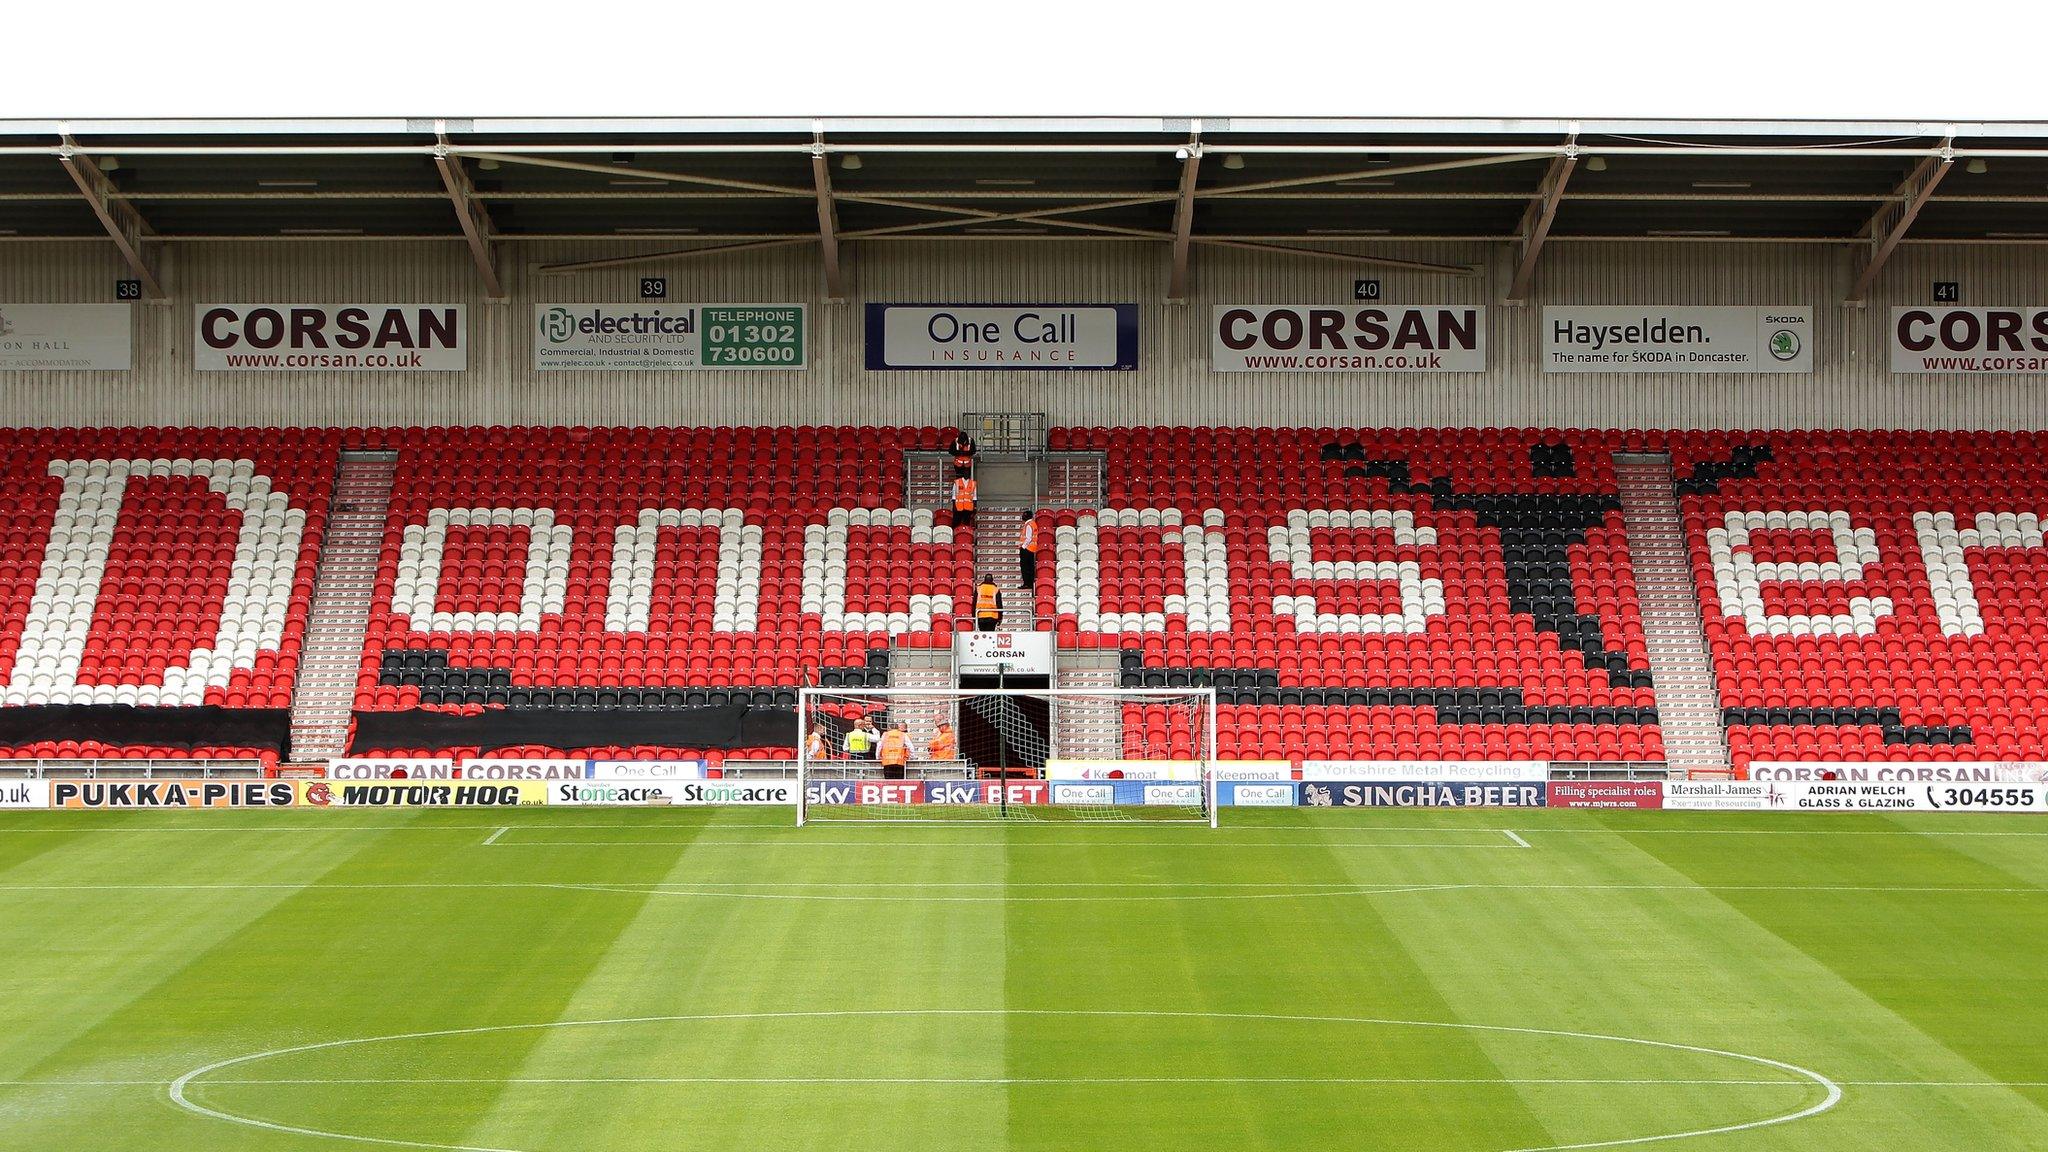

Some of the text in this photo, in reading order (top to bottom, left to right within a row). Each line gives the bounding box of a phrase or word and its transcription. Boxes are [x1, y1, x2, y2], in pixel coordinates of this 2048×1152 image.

[119, 282, 139, 297] 38
[643, 281, 663, 295] 39
[1357, 283, 1377, 297] 40
[1937, 285, 1956, 299] 41
[578, 309, 695, 334] electrical
[709, 311, 795, 322] TELEPHONE
[1765, 315, 1805, 324] ŠKODA
[201, 308, 457, 349] CORSAN
[709, 325, 795, 343] 01302
[927, 313, 1075, 344] One Call
[1219, 309, 1476, 350] CORSAN
[1553, 318, 1711, 350] Hayselden.
[32, 341, 71, 350] HALL
[588, 335, 686, 344] AND SECURITY LTD
[226, 351, 422, 367] www.corsan.co.uk
[540, 349, 597, 357] Commercial,
[709, 347, 795, 362] 730600
[931, 350, 1075, 361] INSURANCE
[1244, 352, 1442, 368] www.corsan.co.uk
[1552, 350, 1750, 363] The name for ŠKODA in Doncaster.
[16, 359, 92, 367] ACCOMMODATION
[540, 360, 694, 368] www.rjelec.co.uk contact@rjelec.co.uk
[997, 637, 1012, 646] N2
[985, 650, 1026, 658] CORSAN
[467, 765, 581, 779] CORSAN
[615, 765, 677, 776] One Call
[1094, 769, 1157, 779] Kemoat
[1216, 770, 1279, 780] Keepmoat
[1322, 764, 1522, 778] Yorkshire Metal Recycling
[1877, 767, 1991, 781] CORSAN
[55, 783, 293, 806] PUKKA-PIES
[343, 786, 451, 805] MOTOR
[454, 786, 519, 805] HOG
[560, 784, 663, 801] Stoneacre
[684, 784, 787, 801] Stoneacre
[806, 782, 918, 805] sky BET
[931, 782, 1043, 804] sky BET
[1062, 788, 1106, 798] One Call
[1151, 788, 1196, 798] One Call
[1240, 788, 1285, 798] One Call
[1343, 785, 1539, 806] SINGHA BEER
[1555, 786, 1657, 799] Filling specialist roles
[1671, 784, 1762, 795] Marshall-James
[1808, 786, 1906, 795] ADRIAN WELCH
[1715, 799, 1762, 809] Resourcing
[1798, 798, 1915, 808] GLASS & GLAZING
[1944, 788, 2034, 806] 304555
